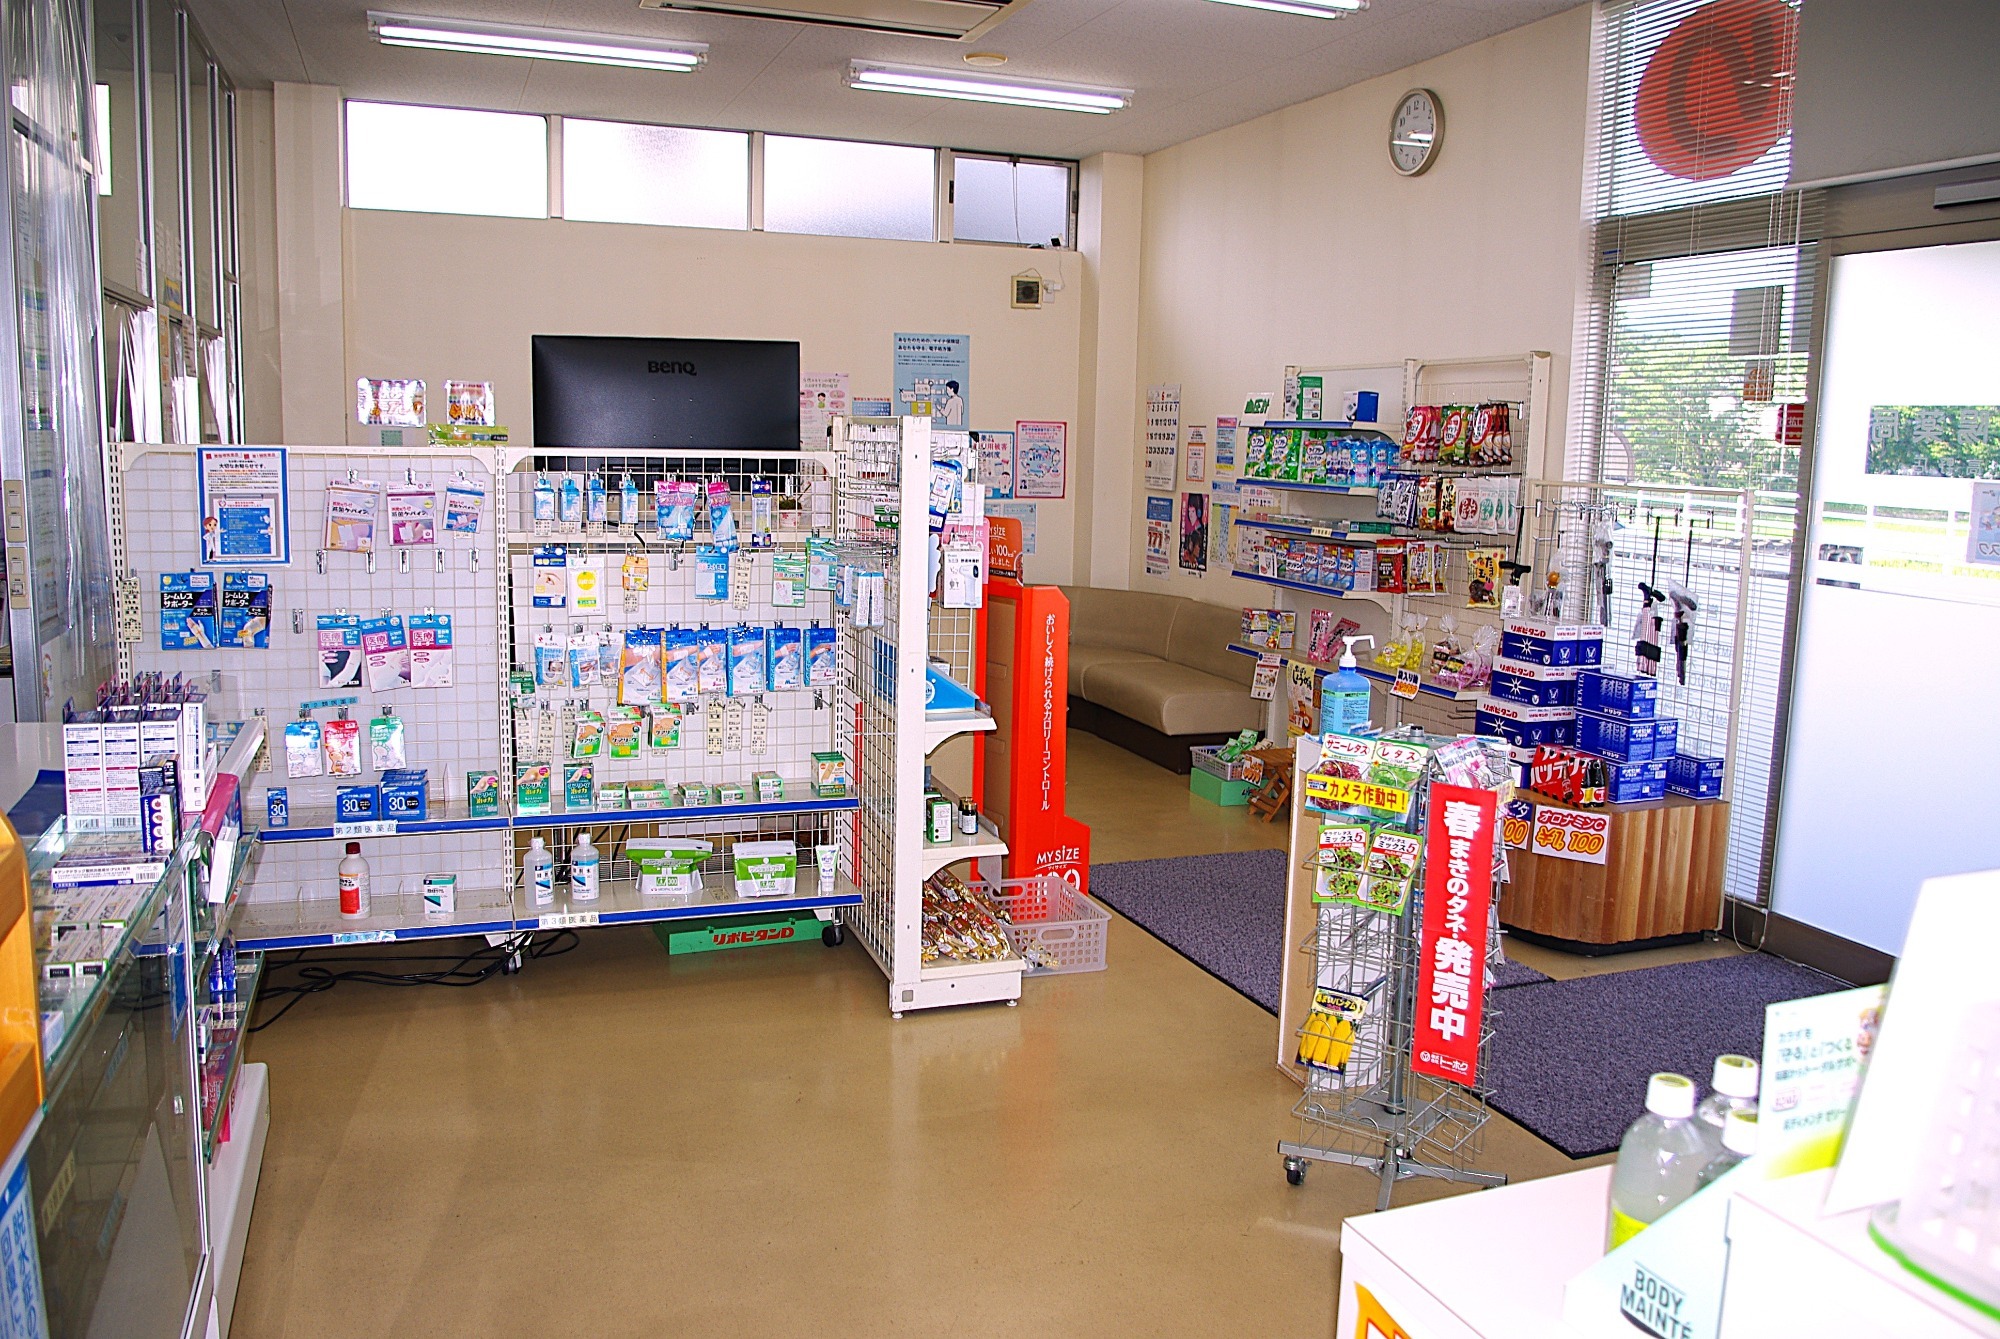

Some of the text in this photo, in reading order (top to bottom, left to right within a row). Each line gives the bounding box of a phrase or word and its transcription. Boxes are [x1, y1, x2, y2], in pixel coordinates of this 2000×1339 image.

[648, 361, 698, 376] BenQ
[163, 592, 193, 600] シームレス
[224, 592, 250, 600] シームレス
[163, 601, 193, 609] サポーター
[414, 631, 434, 642] 医療
[1511, 624, 1546, 637] リポビタンD
[366, 635, 389, 646] 医療
[1499, 663, 1535, 677] リポビタンD
[1041, 613, 1056, 810] おいしく続けられるカロリーコントロール
[1483, 703, 1518, 718] リポビタンD
[1327, 740, 1368, 756] サニーレタス
[1382, 748, 1415, 761] レタス
[1330, 780, 1405, 810] カメラ作動中！
[1538, 810, 1606, 831] オロナミンC
[336, 823, 396, 835] 第2類医薬品
[1325, 832, 1363, 843] ミックス 5
[1378, 841, 1417, 853] ミックス 5
[713, 926, 795, 946] リポビタンD
[1440, 1056, 1468, 1071] トーホク
[1635, 1268, 1683, 1315] BODY
[1622, 1283, 1693, 1339] MAINTÉ
